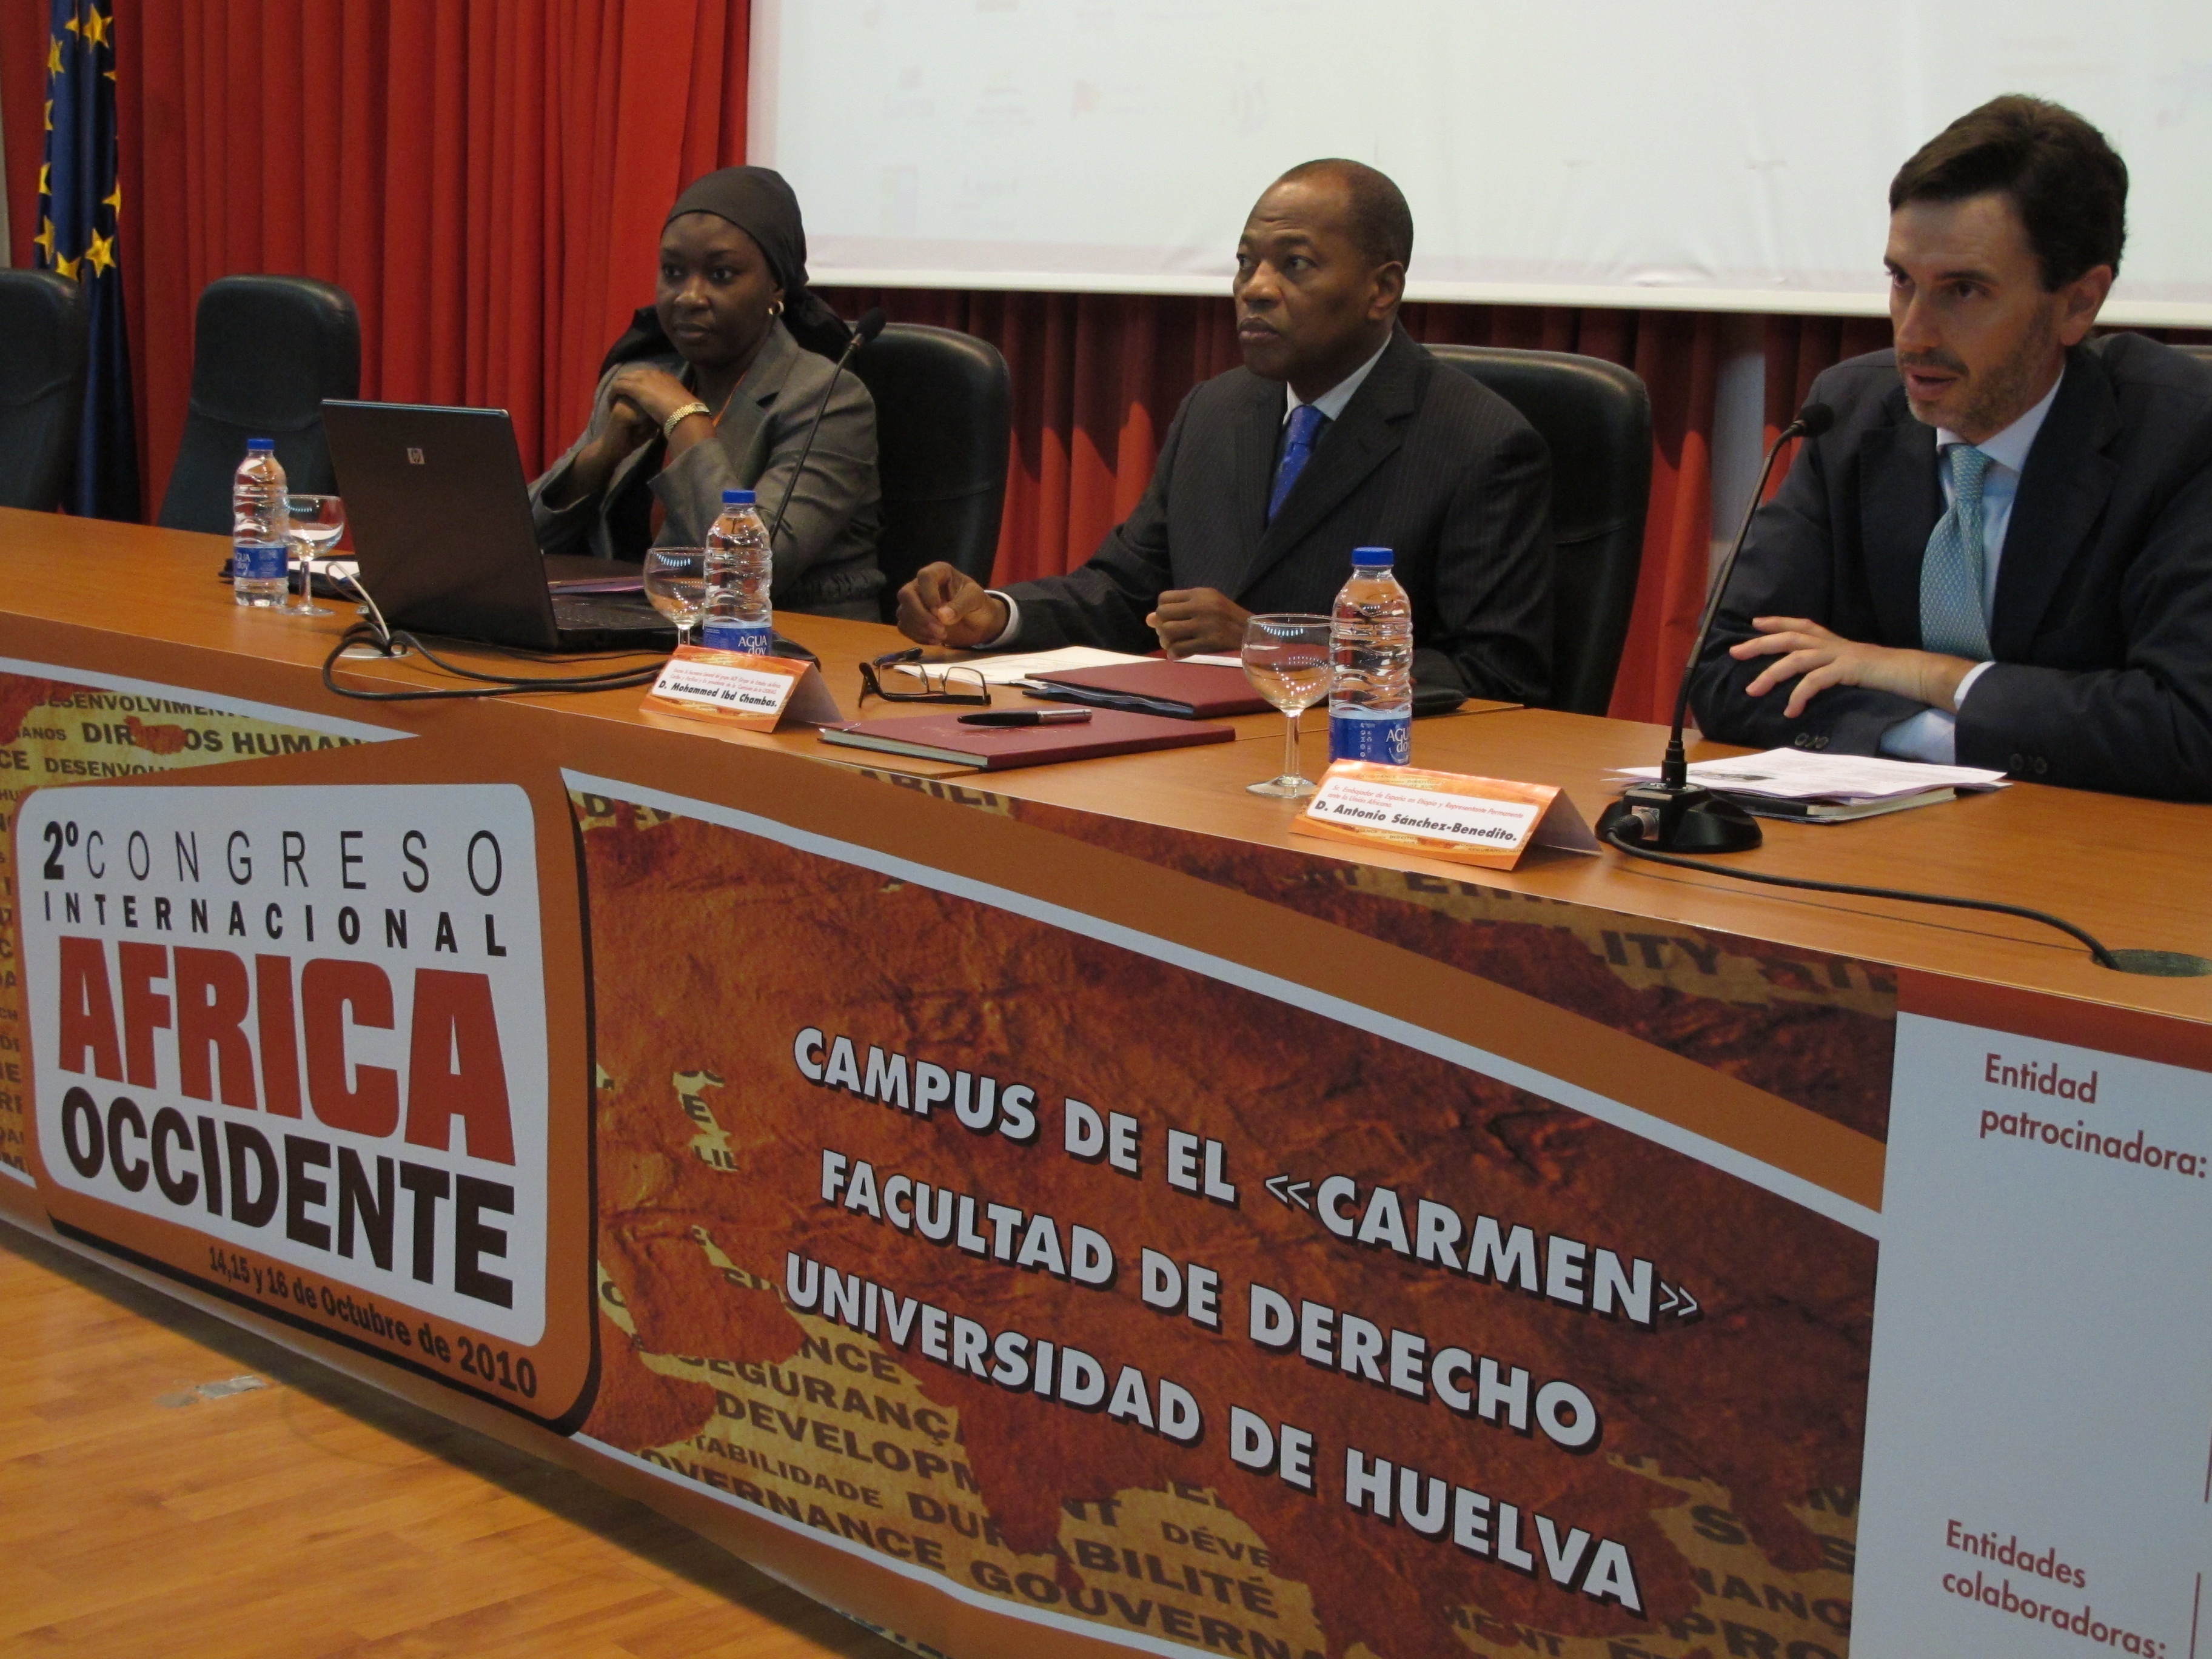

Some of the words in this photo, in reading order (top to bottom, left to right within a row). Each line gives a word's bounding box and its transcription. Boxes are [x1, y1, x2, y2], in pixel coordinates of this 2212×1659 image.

[738, 635, 768, 648] AGUA
[659, 680, 667, 689] D.
[671, 682, 719, 697] Mohammed
[739, 693, 777, 708] Chambas.
[1315, 800, 1329, 811] D.
[1333, 804, 1387, 821] Antonio
[1392, 813, 1517, 842] Sánchez-Benedito.
[1342, 786, 1373, 797] Embajador
[1384, 793, 1407, 802] España
[1444, 802, 1487, 814] Representante
[1487, 808, 1524, 819] Permanente
[1349, 796, 1365, 804] Unión
[44, 820, 79, 880] 2º
[86, 829, 503, 897] CONGRESO
[44, 890, 507, 957] INTERNACIONAL
[58, 935, 516, 1166] AFRICA
[1983, 1052, 2099, 1105] Entidad
[793, 1027, 1037, 1141] CAMPUS
[1064, 1096, 1140, 1173] DE
[1167, 1128, 1237, 1204] EL
[1264, 1174, 1698, 1326] «CARMEN»
[1979, 1107, 2208, 1179] patrocinadora:
[62, 1086, 515, 1310] OCCIDENTE
[209, 1245, 250, 1284] 14,15
[253, 1266, 263, 1294] y
[267, 1269, 289, 1298] 16
[293, 1276, 317, 1310] de
[321, 1285, 412, 1347] Octubre
[418, 1322, 451, 1363] de
[457, 1336, 538, 1399] 2010
[821, 1147, 1116, 1286] FACULTAD
[1141, 1245, 1219, 1327] DE
[1249, 1282, 1598, 1447] DERECHO
[678, 1356, 965, 1447] EGURANÇ
[786, 1251, 1201, 1442] UNIVERSIDAD
[1230, 1404, 1313, 1489] DE
[1345, 1446, 1642, 1612] HUELVA
[686, 1434, 883, 1510] TABILIDADE
[1945, 1518, 2086, 1589] Entidades
[1942, 1569, 2167, 1659] colaboradoras:
